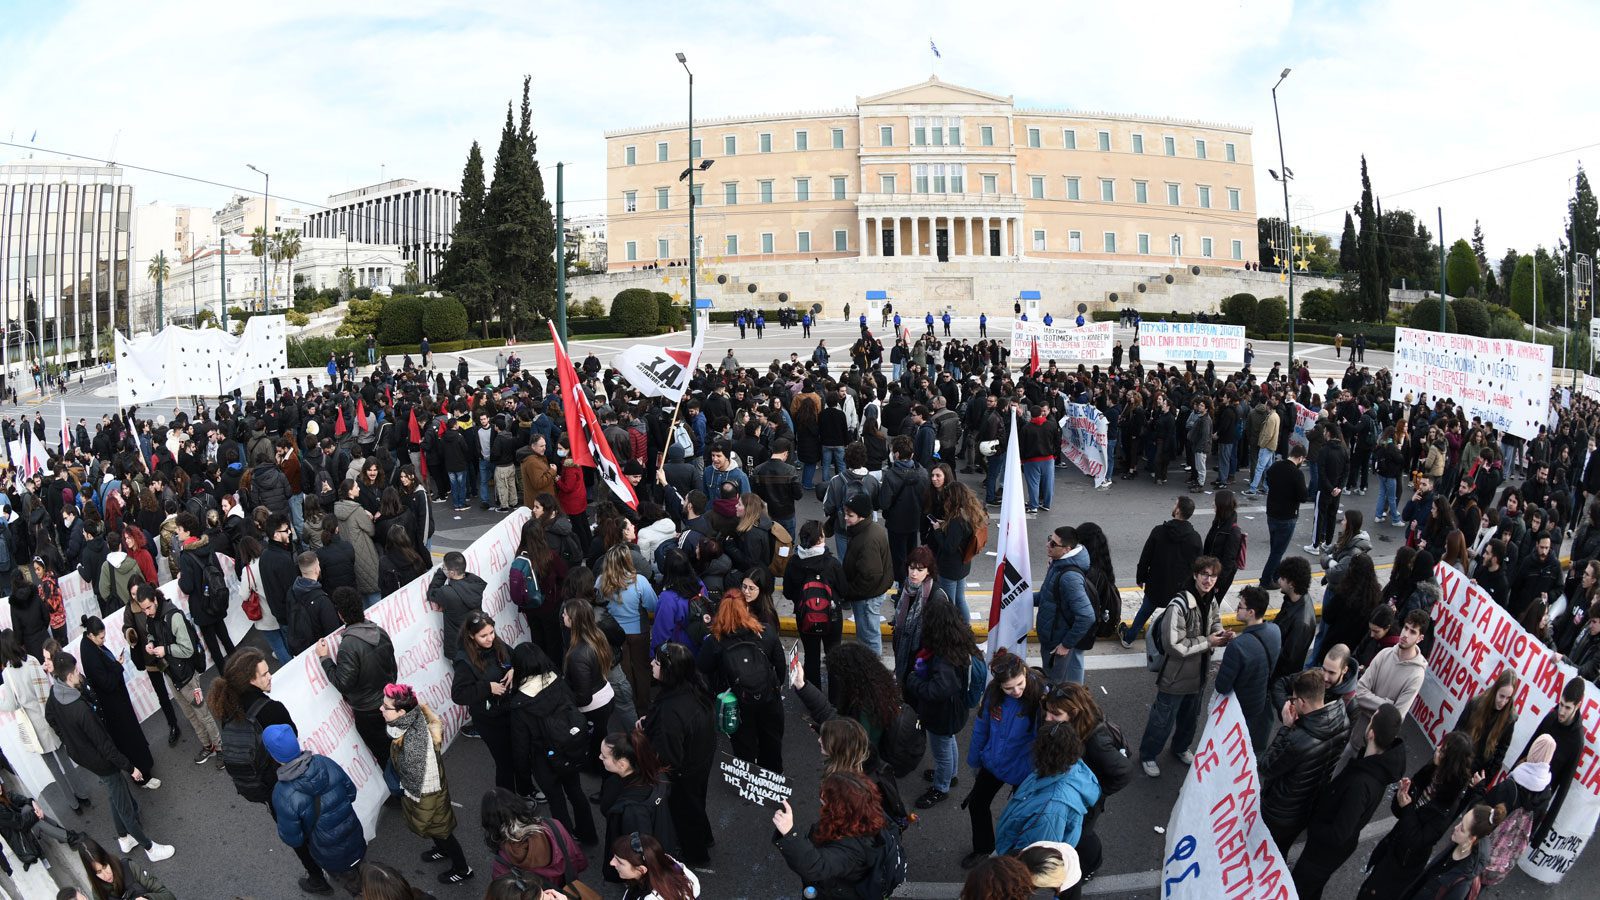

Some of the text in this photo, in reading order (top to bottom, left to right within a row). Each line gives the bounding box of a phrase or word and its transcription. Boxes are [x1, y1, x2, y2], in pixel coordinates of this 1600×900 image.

[1141, 323, 1168, 333] ΠΤΥΧΙΑ
[1459, 586, 1494, 634] ΣΤΑ
[1490, 617, 1566, 704] ΙΔΙΩΤΙΚΑ
[1462, 633, 1491, 674] ΜΕ
[733, 758, 786, 783] ΟΧΙ ΣΤΗΝ
[1194, 738, 1220, 784] ΣΕ
[723, 772, 789, 803] ΤΗΣ ΠΑΙΔΕΙΑΣ
[739, 788, 765, 806] ΜΑΣ
[1222, 722, 1258, 837] ΠΤΥΧΙΑ
